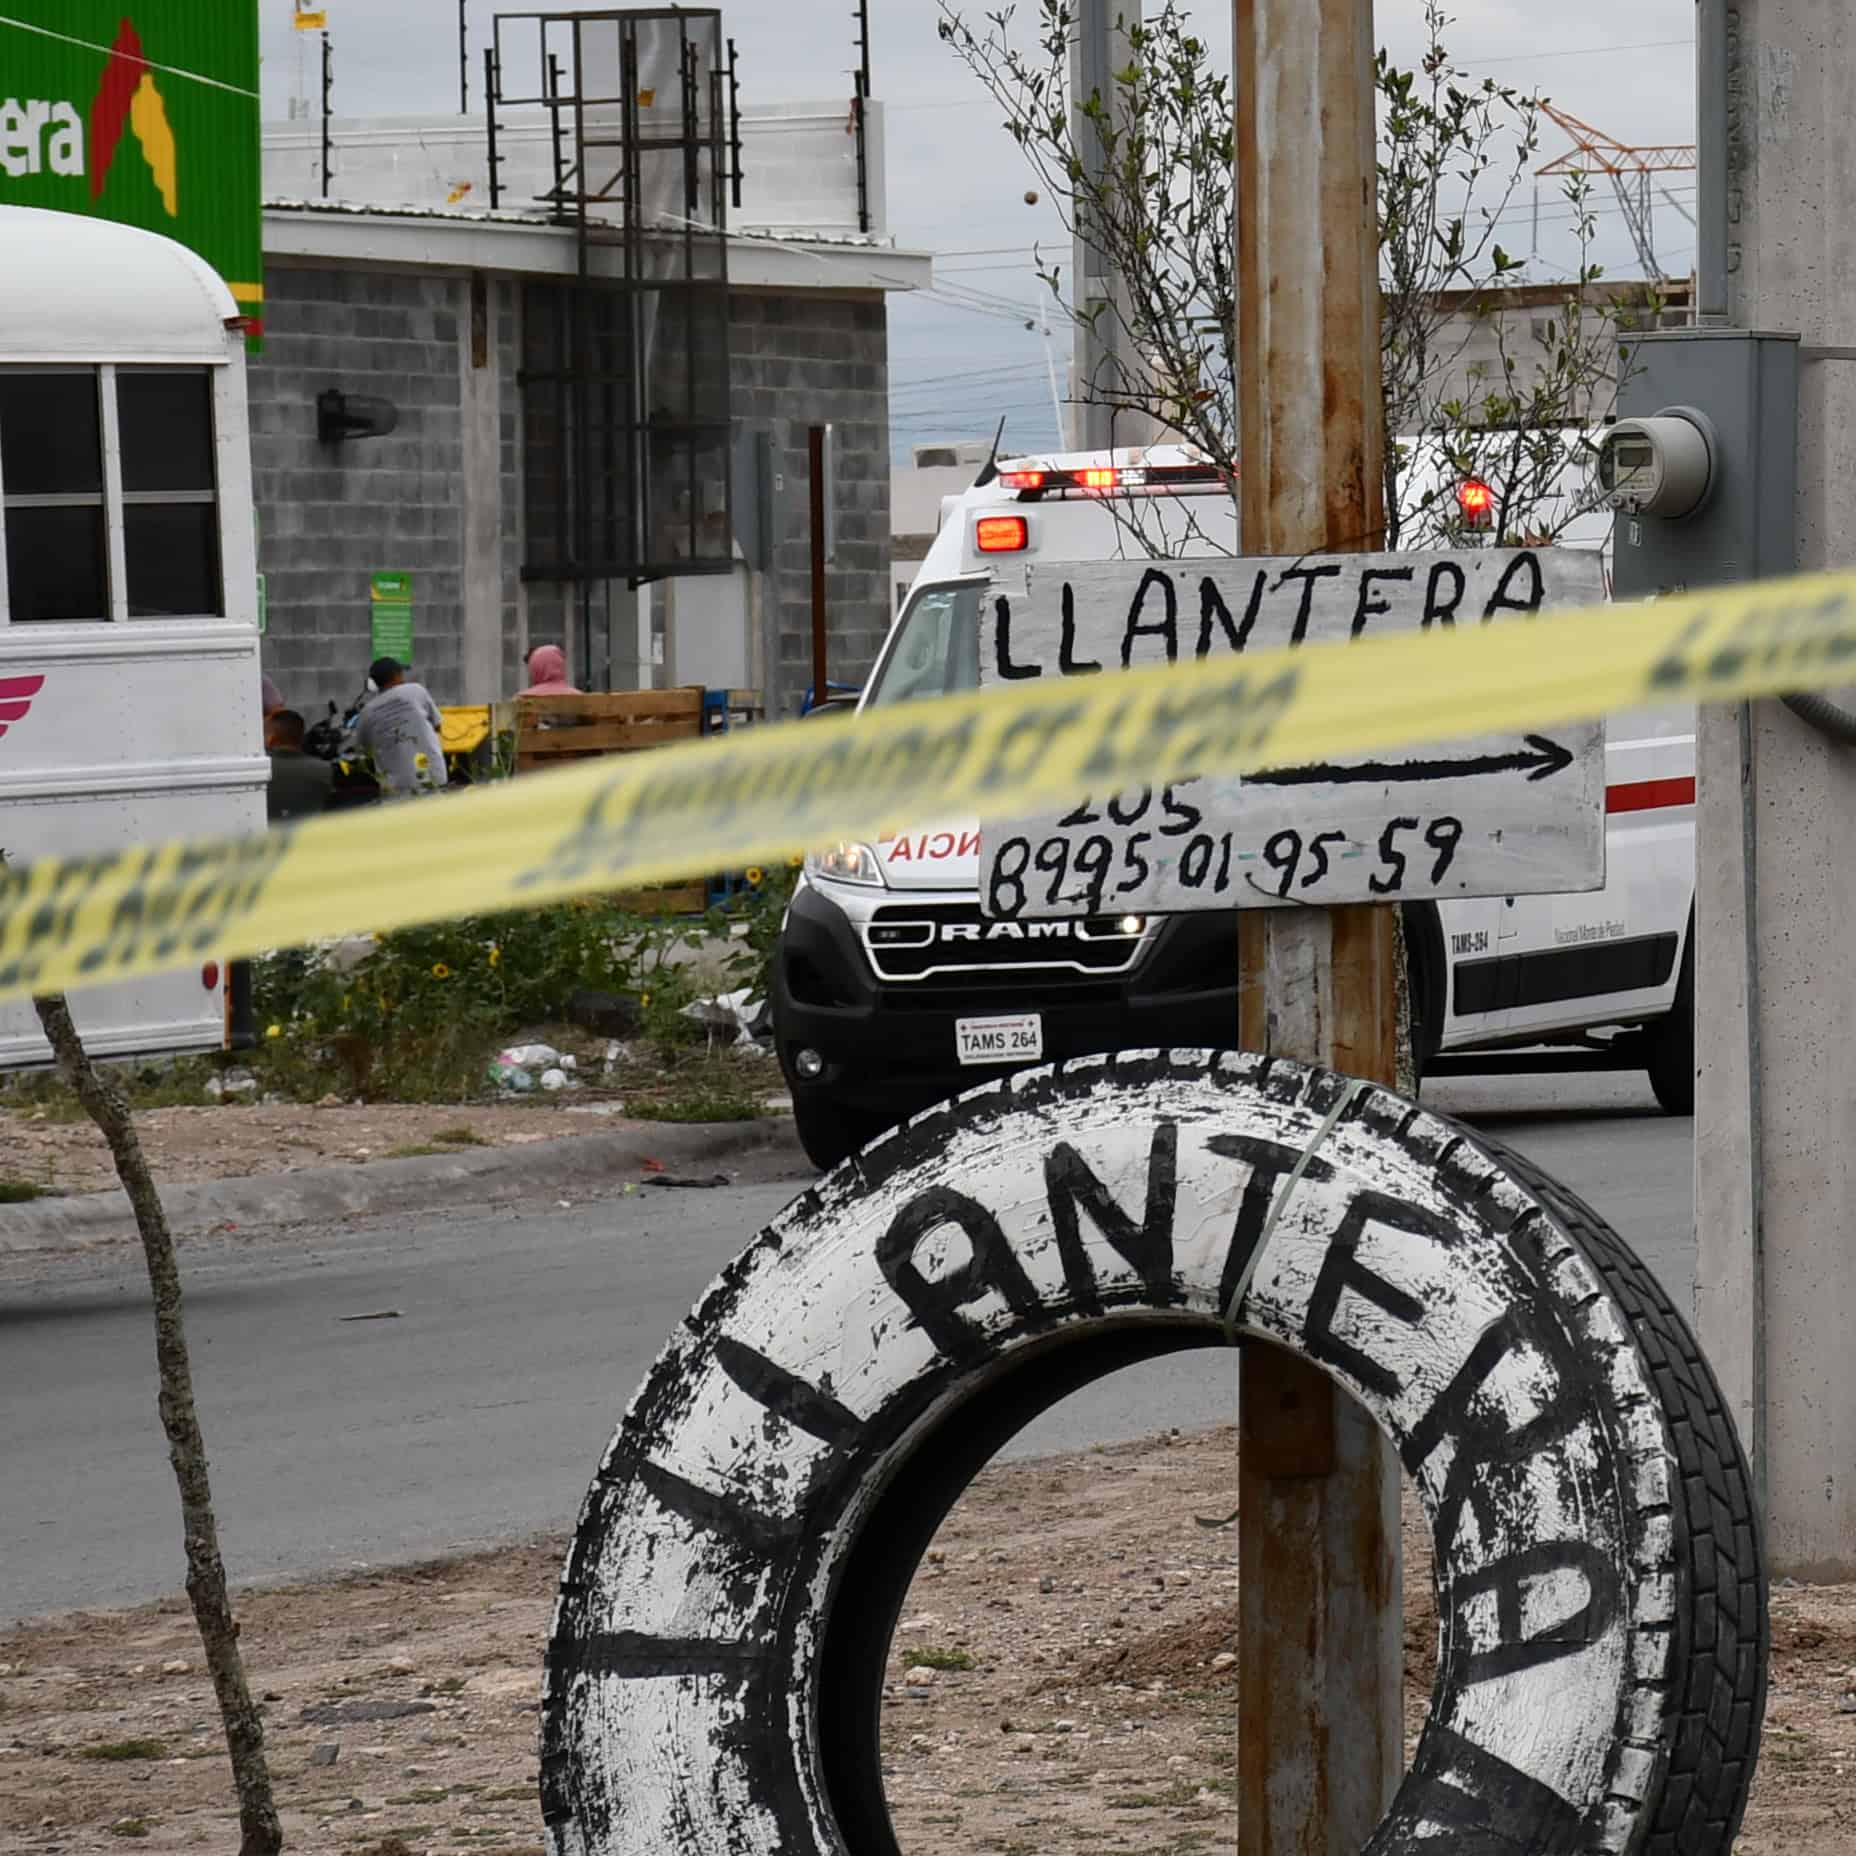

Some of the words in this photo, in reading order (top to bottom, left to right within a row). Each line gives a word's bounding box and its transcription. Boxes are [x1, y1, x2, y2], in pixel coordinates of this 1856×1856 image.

[940, 921, 1070, 942] RAM
[961, 1033, 1006, 1051] TAMS
[1011, 1031, 1037, 1048] 264
